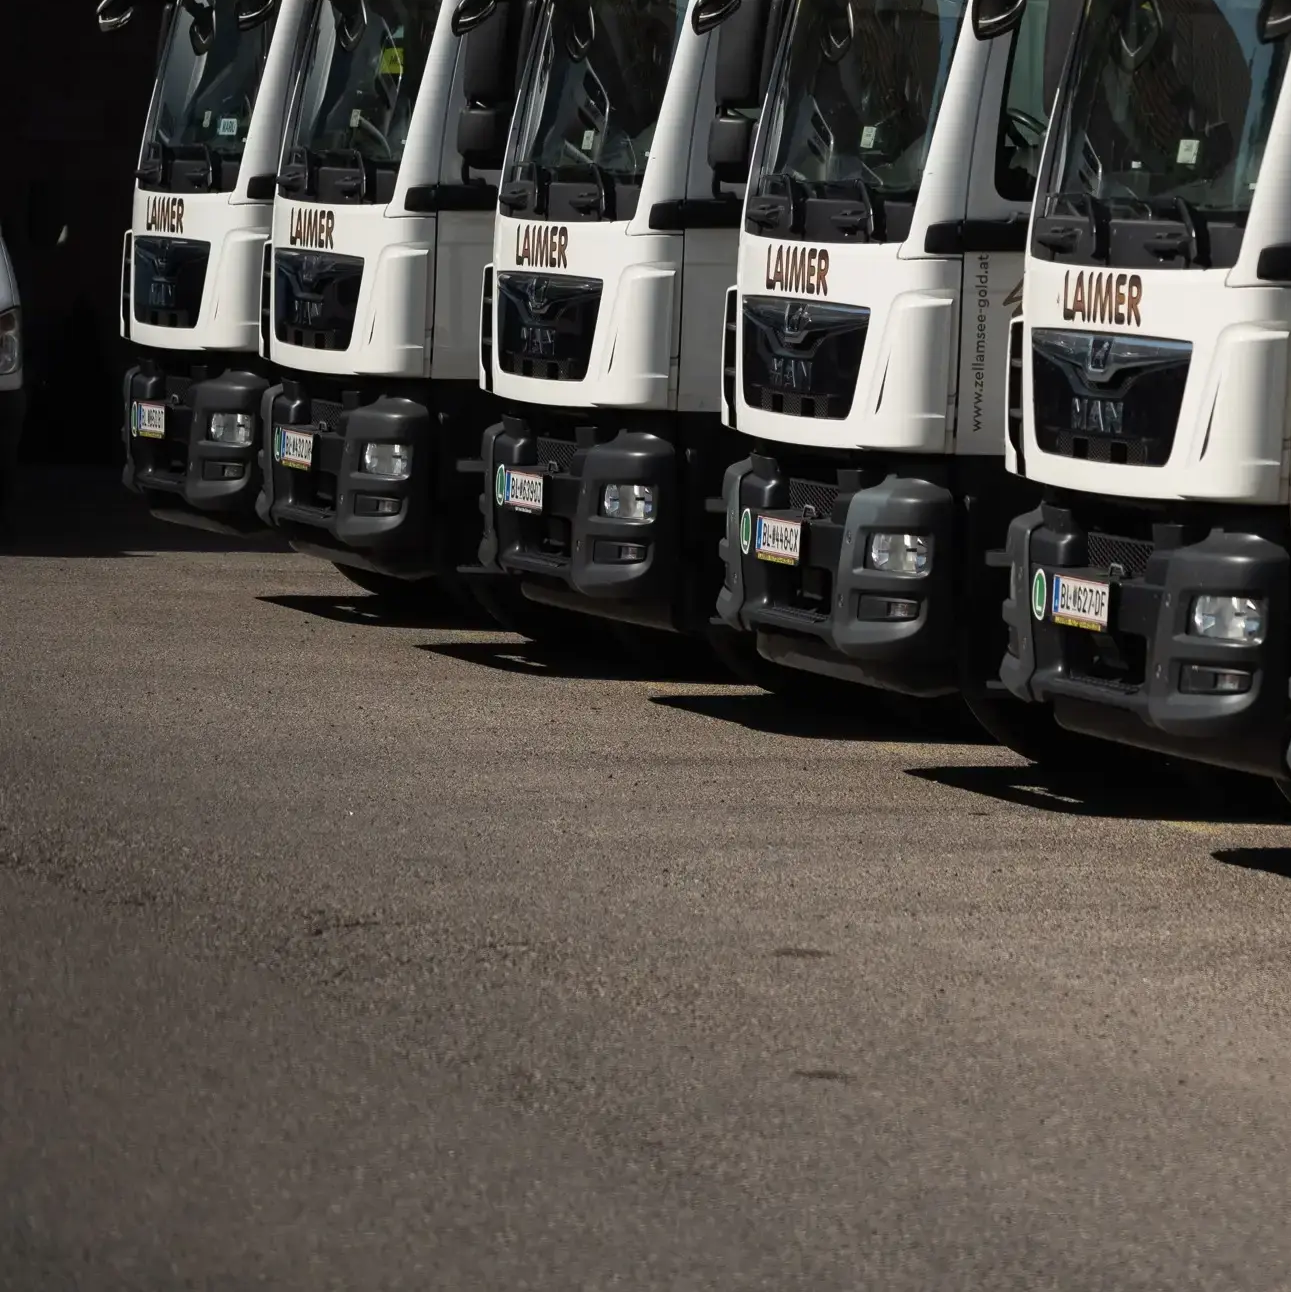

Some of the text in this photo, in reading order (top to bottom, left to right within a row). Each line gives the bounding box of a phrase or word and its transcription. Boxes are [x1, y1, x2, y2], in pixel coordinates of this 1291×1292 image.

[146, 196, 184, 234] LAIMER
[289, 207, 335, 249] LAIMER
[515, 224, 569, 269] LAIMER
[765, 243, 829, 296] LAIMER
[1063, 270, 1143, 327] LAIMER
[971, 252, 990, 433] www.zellamsee-gold.at
[1071, 397, 1124, 434] MAN
